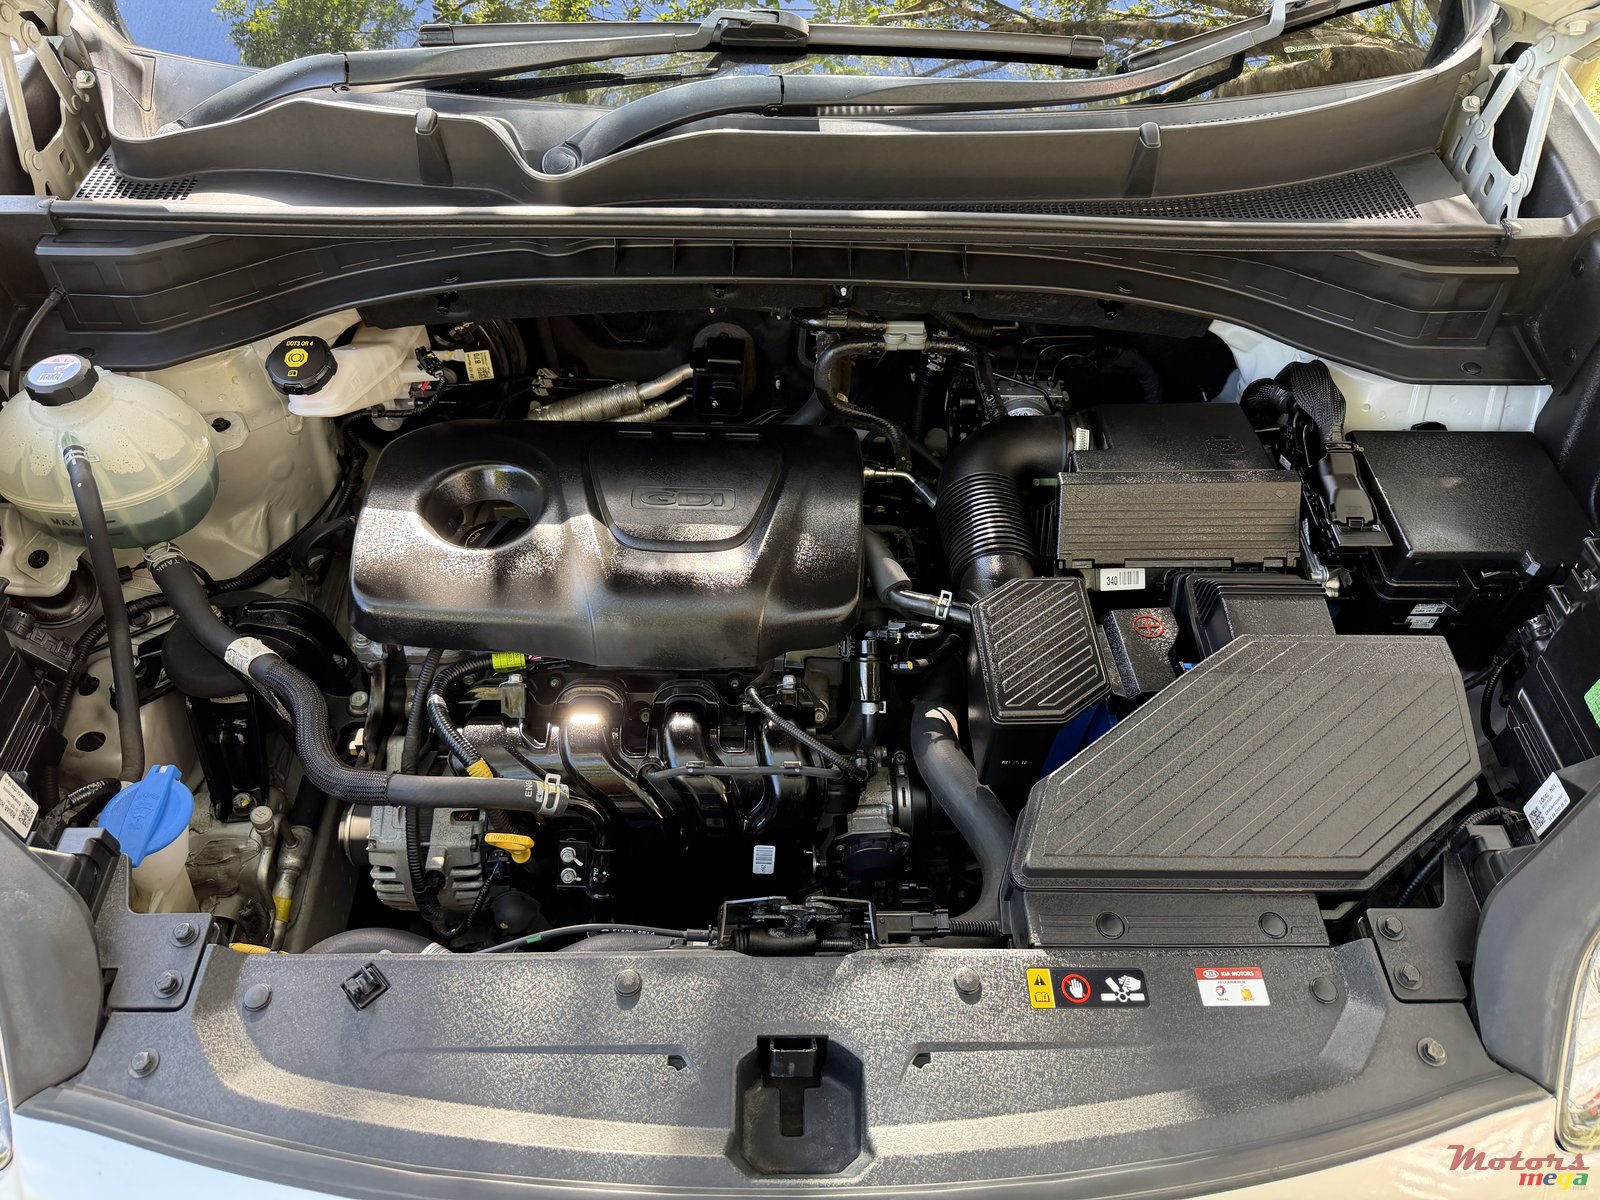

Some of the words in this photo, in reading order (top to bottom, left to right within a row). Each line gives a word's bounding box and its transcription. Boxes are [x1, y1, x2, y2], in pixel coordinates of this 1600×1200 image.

[640, 491, 724, 506] GDI
[50, 517, 79, 527] MAX
[156, 558, 181, 573] TANK
[1106, 576, 1118, 586] 340
